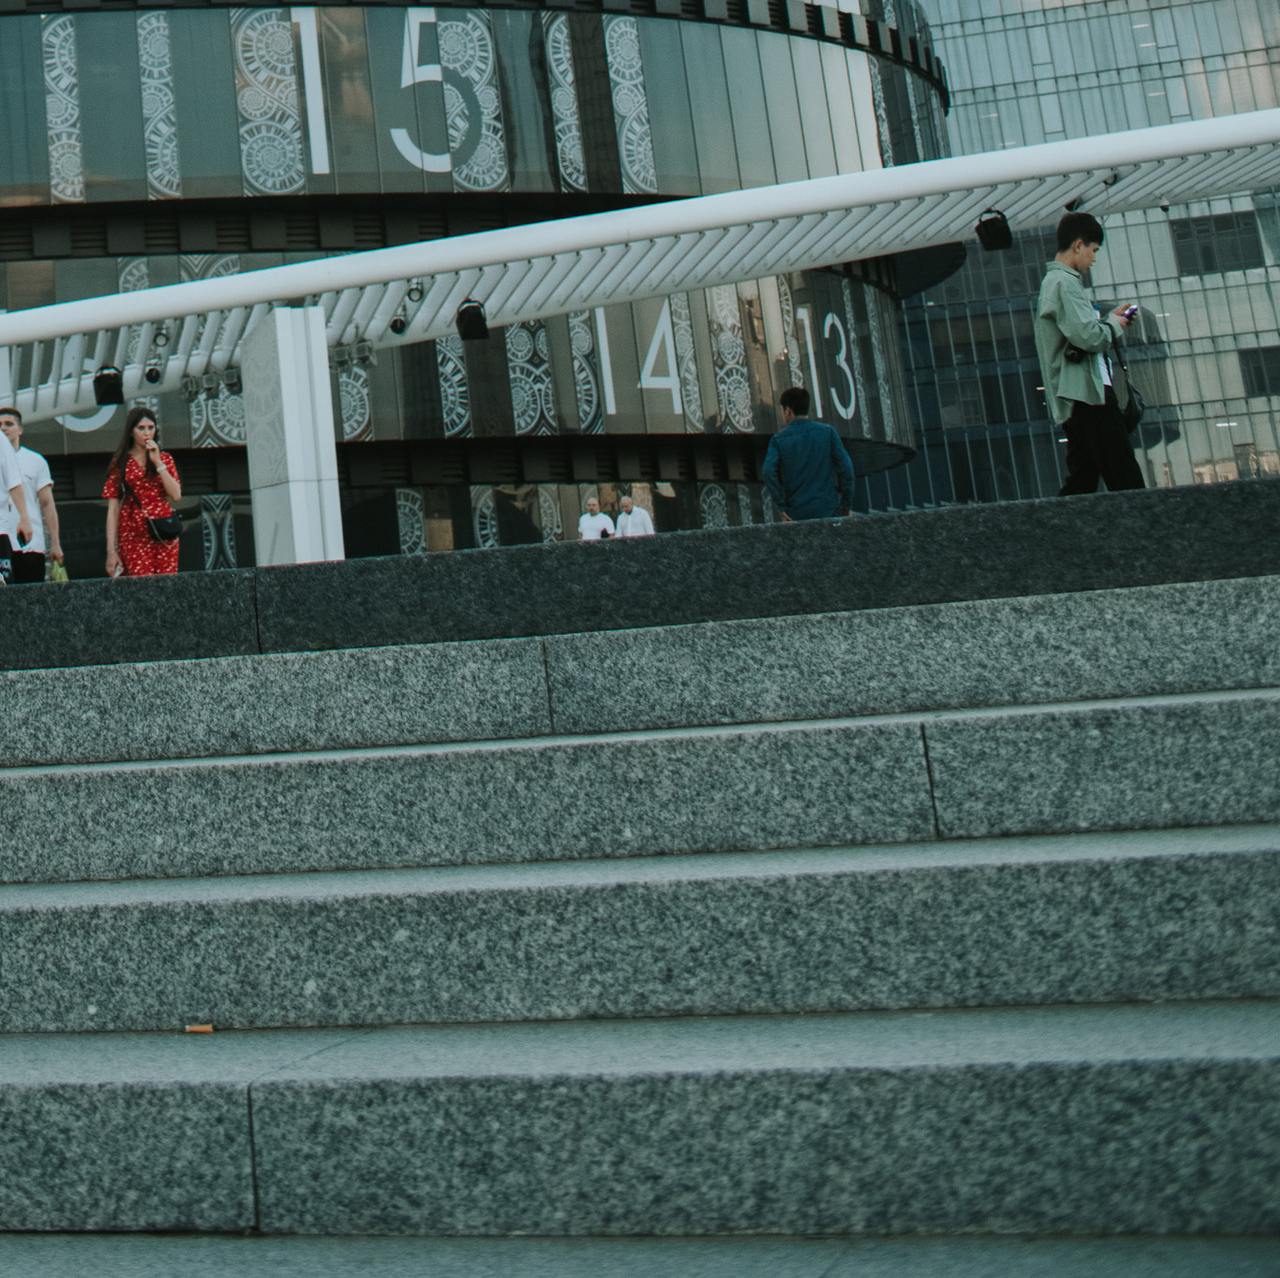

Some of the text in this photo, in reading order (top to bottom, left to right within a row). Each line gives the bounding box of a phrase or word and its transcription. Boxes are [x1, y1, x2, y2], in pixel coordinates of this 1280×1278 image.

[290, 6, 483, 174] 15
[594, 297, 684, 415] 14
[796, 307, 856, 420] 13
